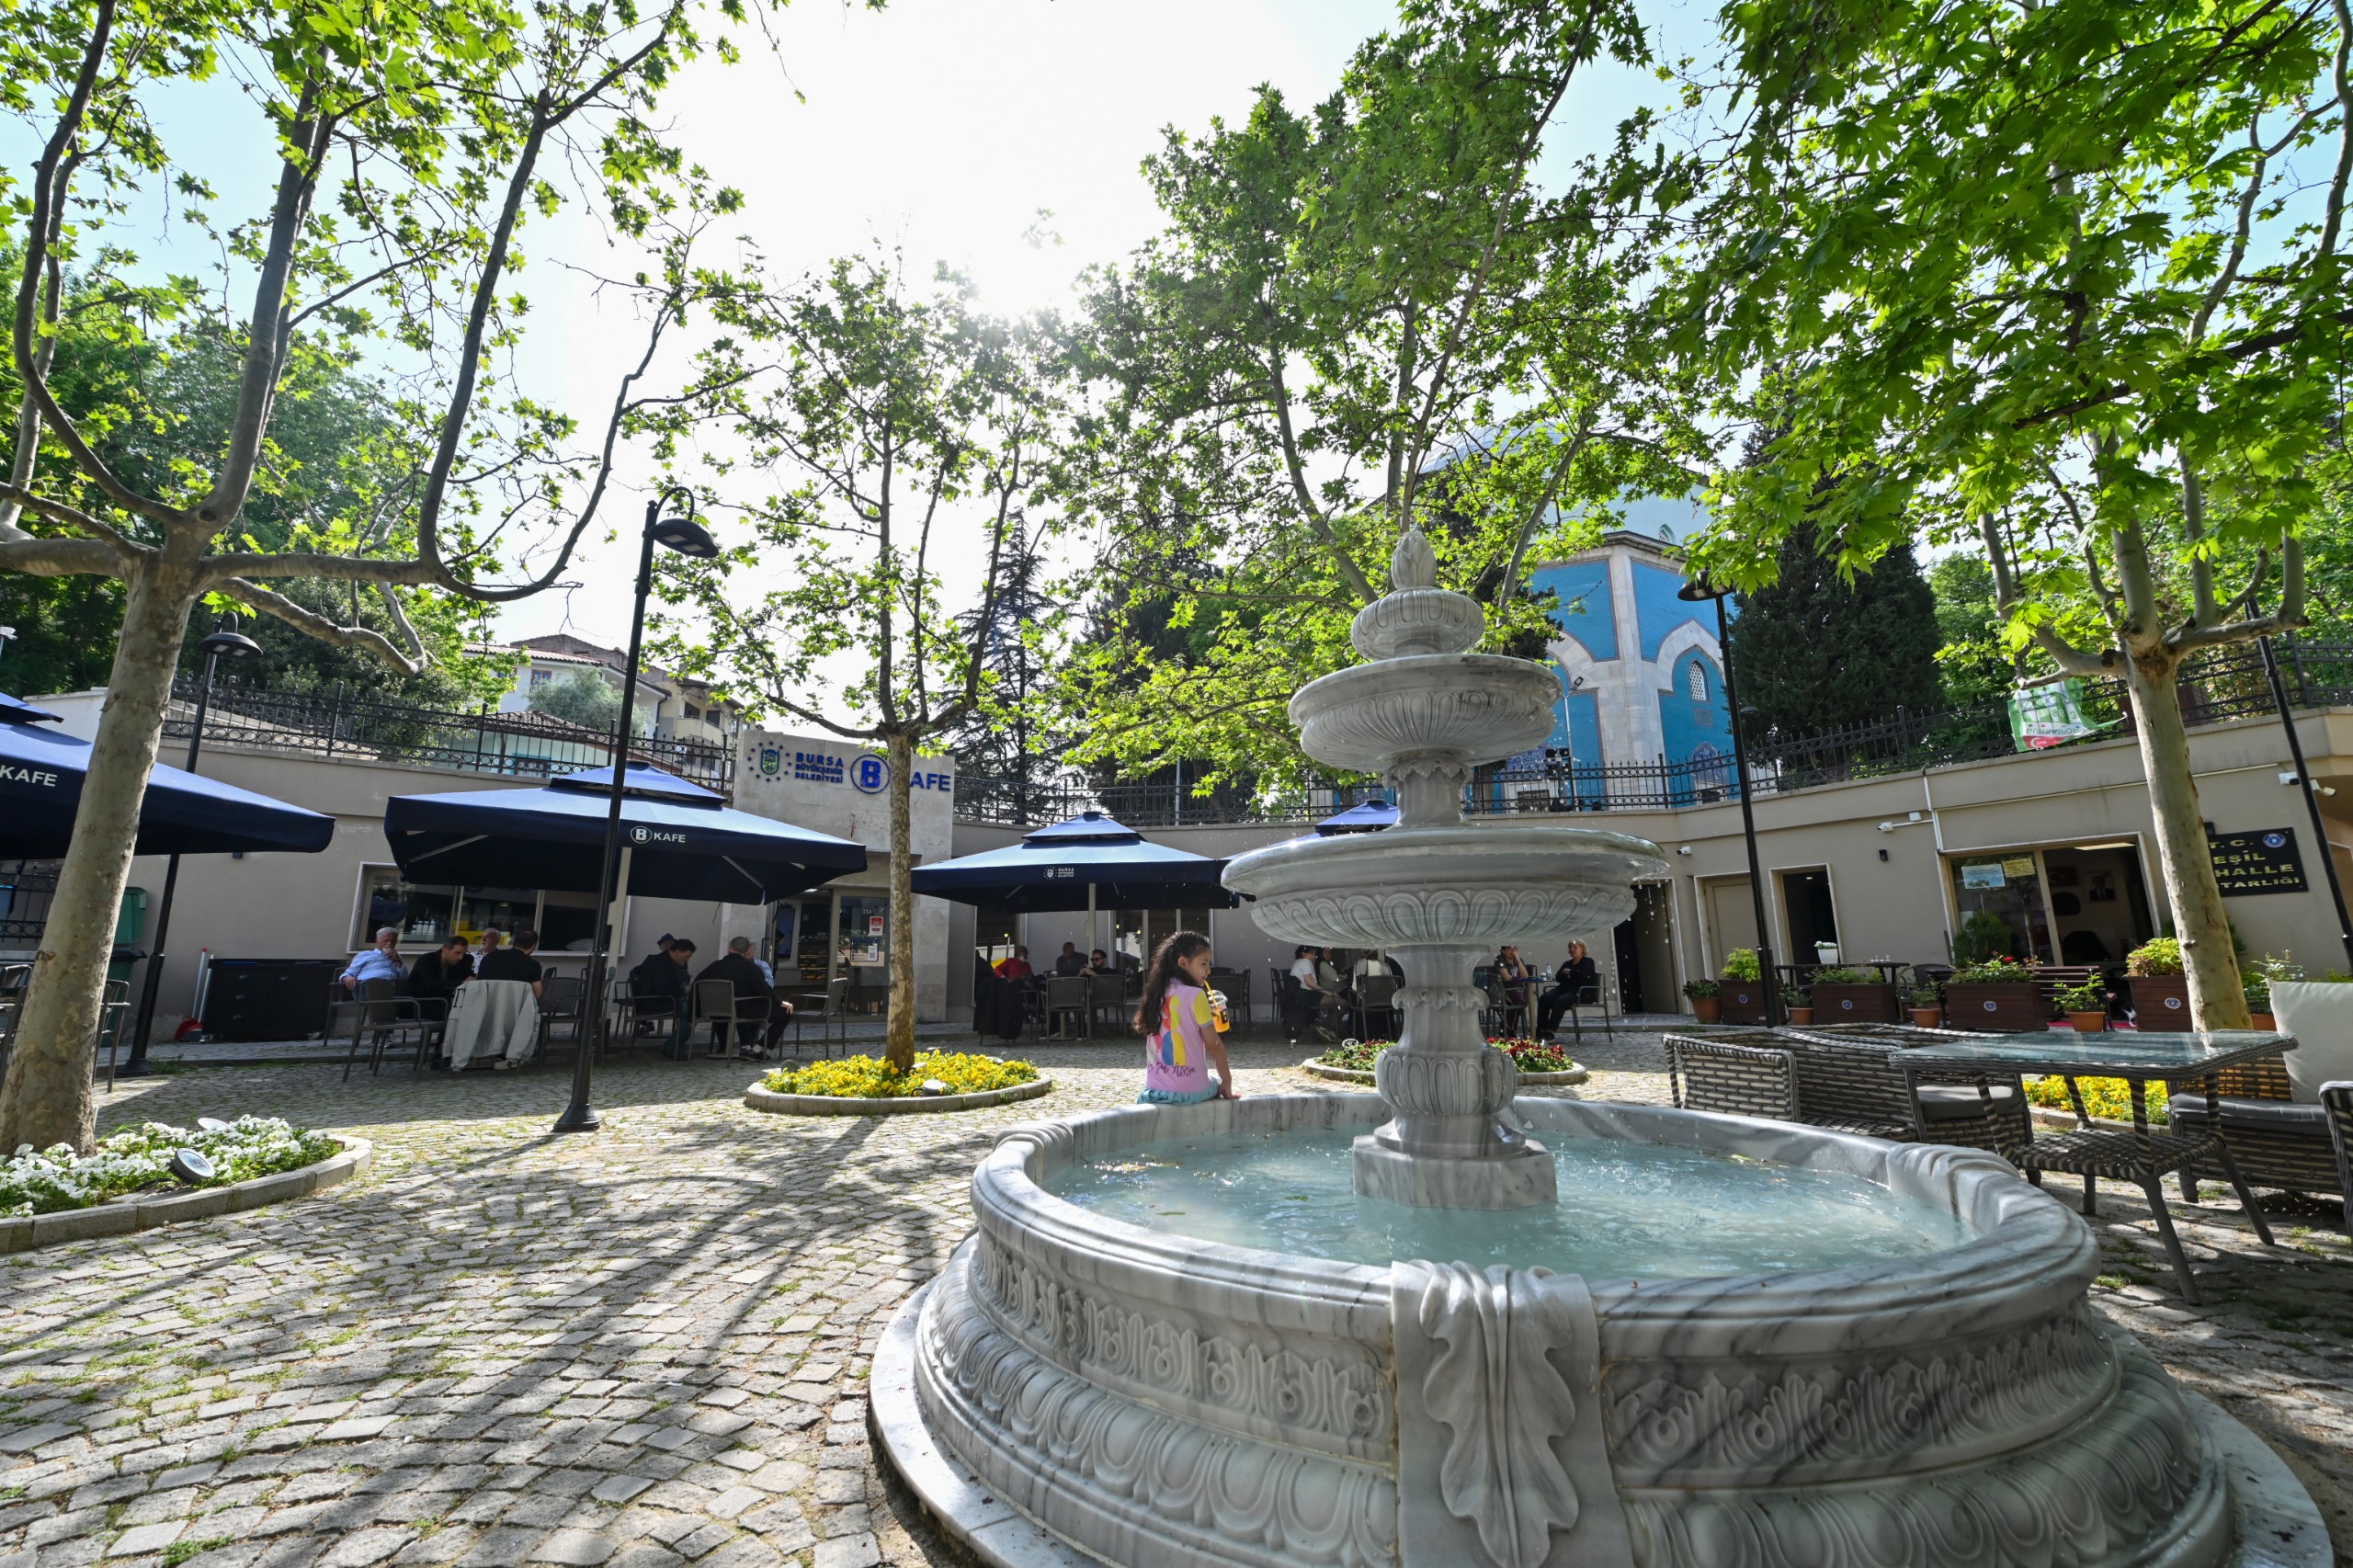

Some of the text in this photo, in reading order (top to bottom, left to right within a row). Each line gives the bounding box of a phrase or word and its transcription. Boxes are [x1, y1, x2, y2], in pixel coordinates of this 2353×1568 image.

[796, 752, 844, 767] BURSA
[0, 765, 58, 788] KAFE
[794, 772, 843, 784] BELEDİYESİ
[860, 760, 951, 791] B AFE
[635, 828, 687, 843] B KAFE
[2212, 850, 2266, 865] EŞİL
[2214, 864, 2294, 878] HALLE
[2220, 876, 2300, 889] TARLIĞI
